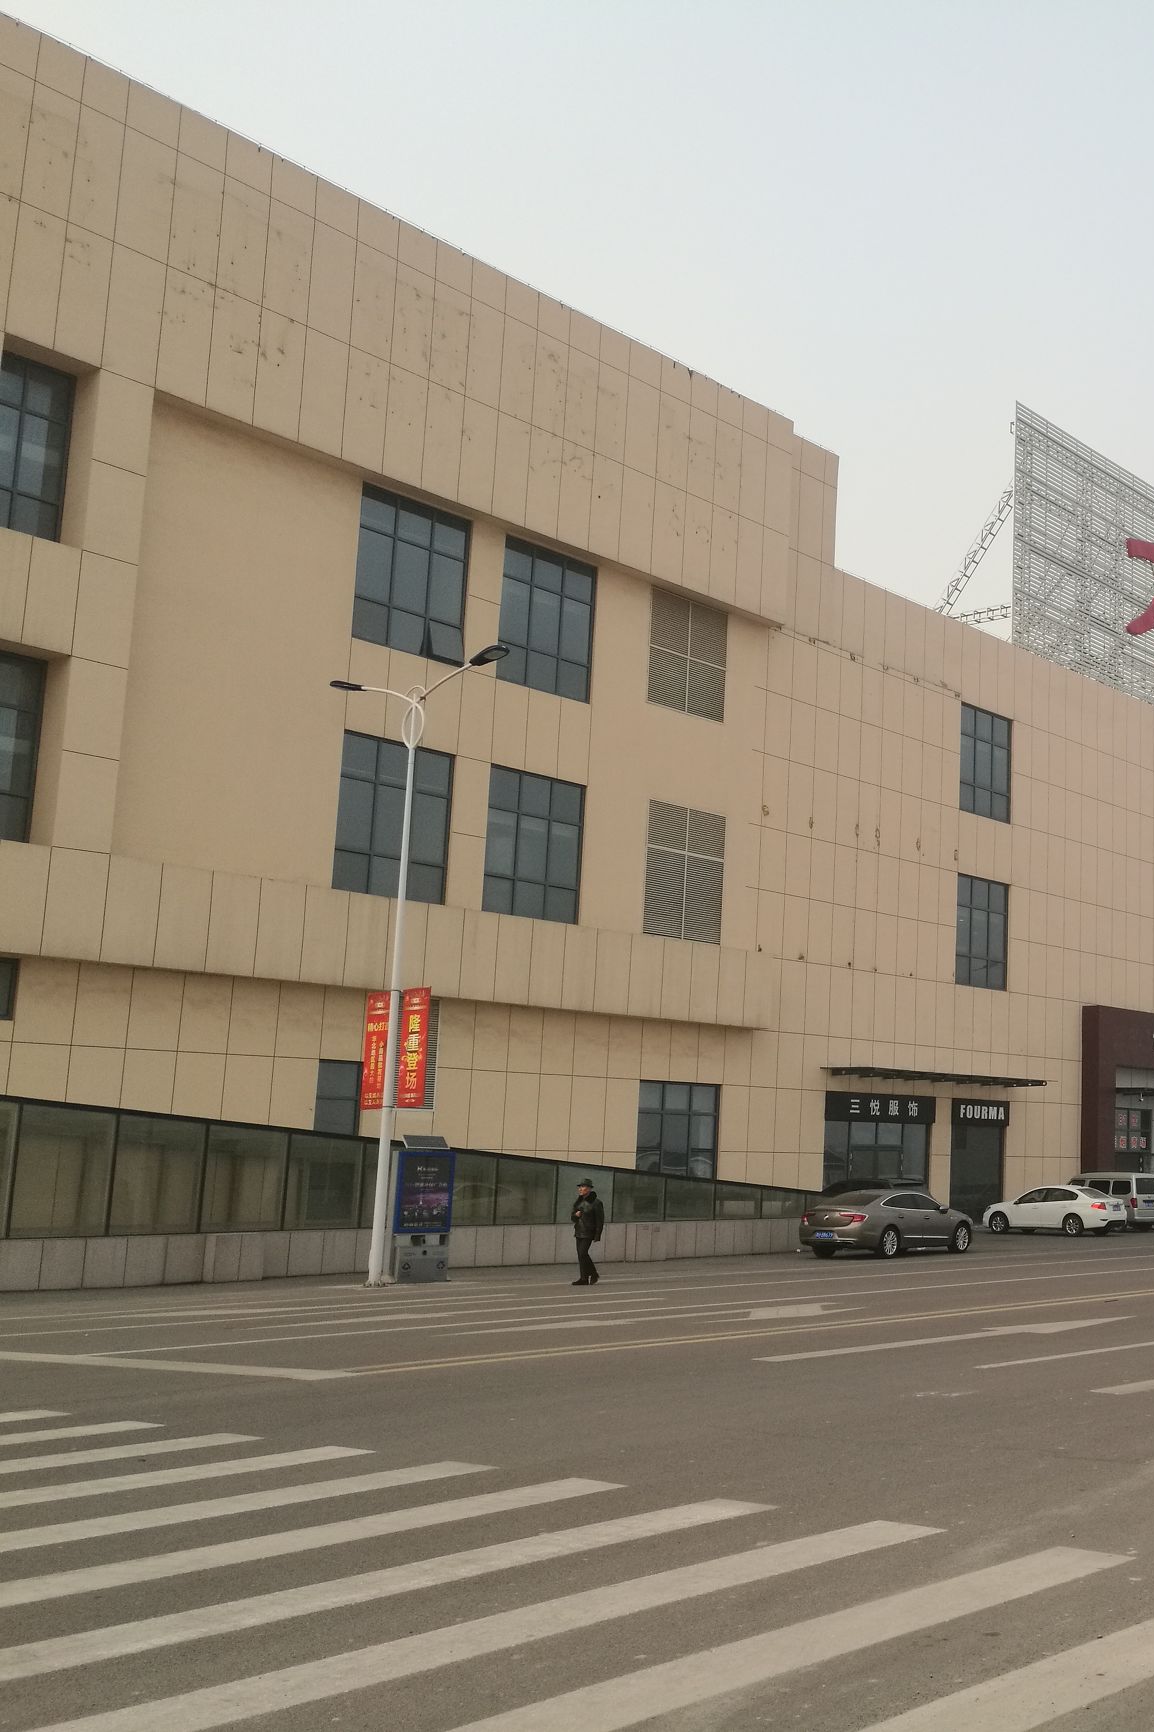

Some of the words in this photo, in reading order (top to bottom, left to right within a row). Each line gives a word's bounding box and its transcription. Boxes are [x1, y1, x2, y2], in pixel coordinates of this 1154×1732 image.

[405, 1014, 421, 1090] 隆重登场
[850, 1099, 918, 1117] 三悦服饰
[960, 1104, 1005, 1120] FOURMA
